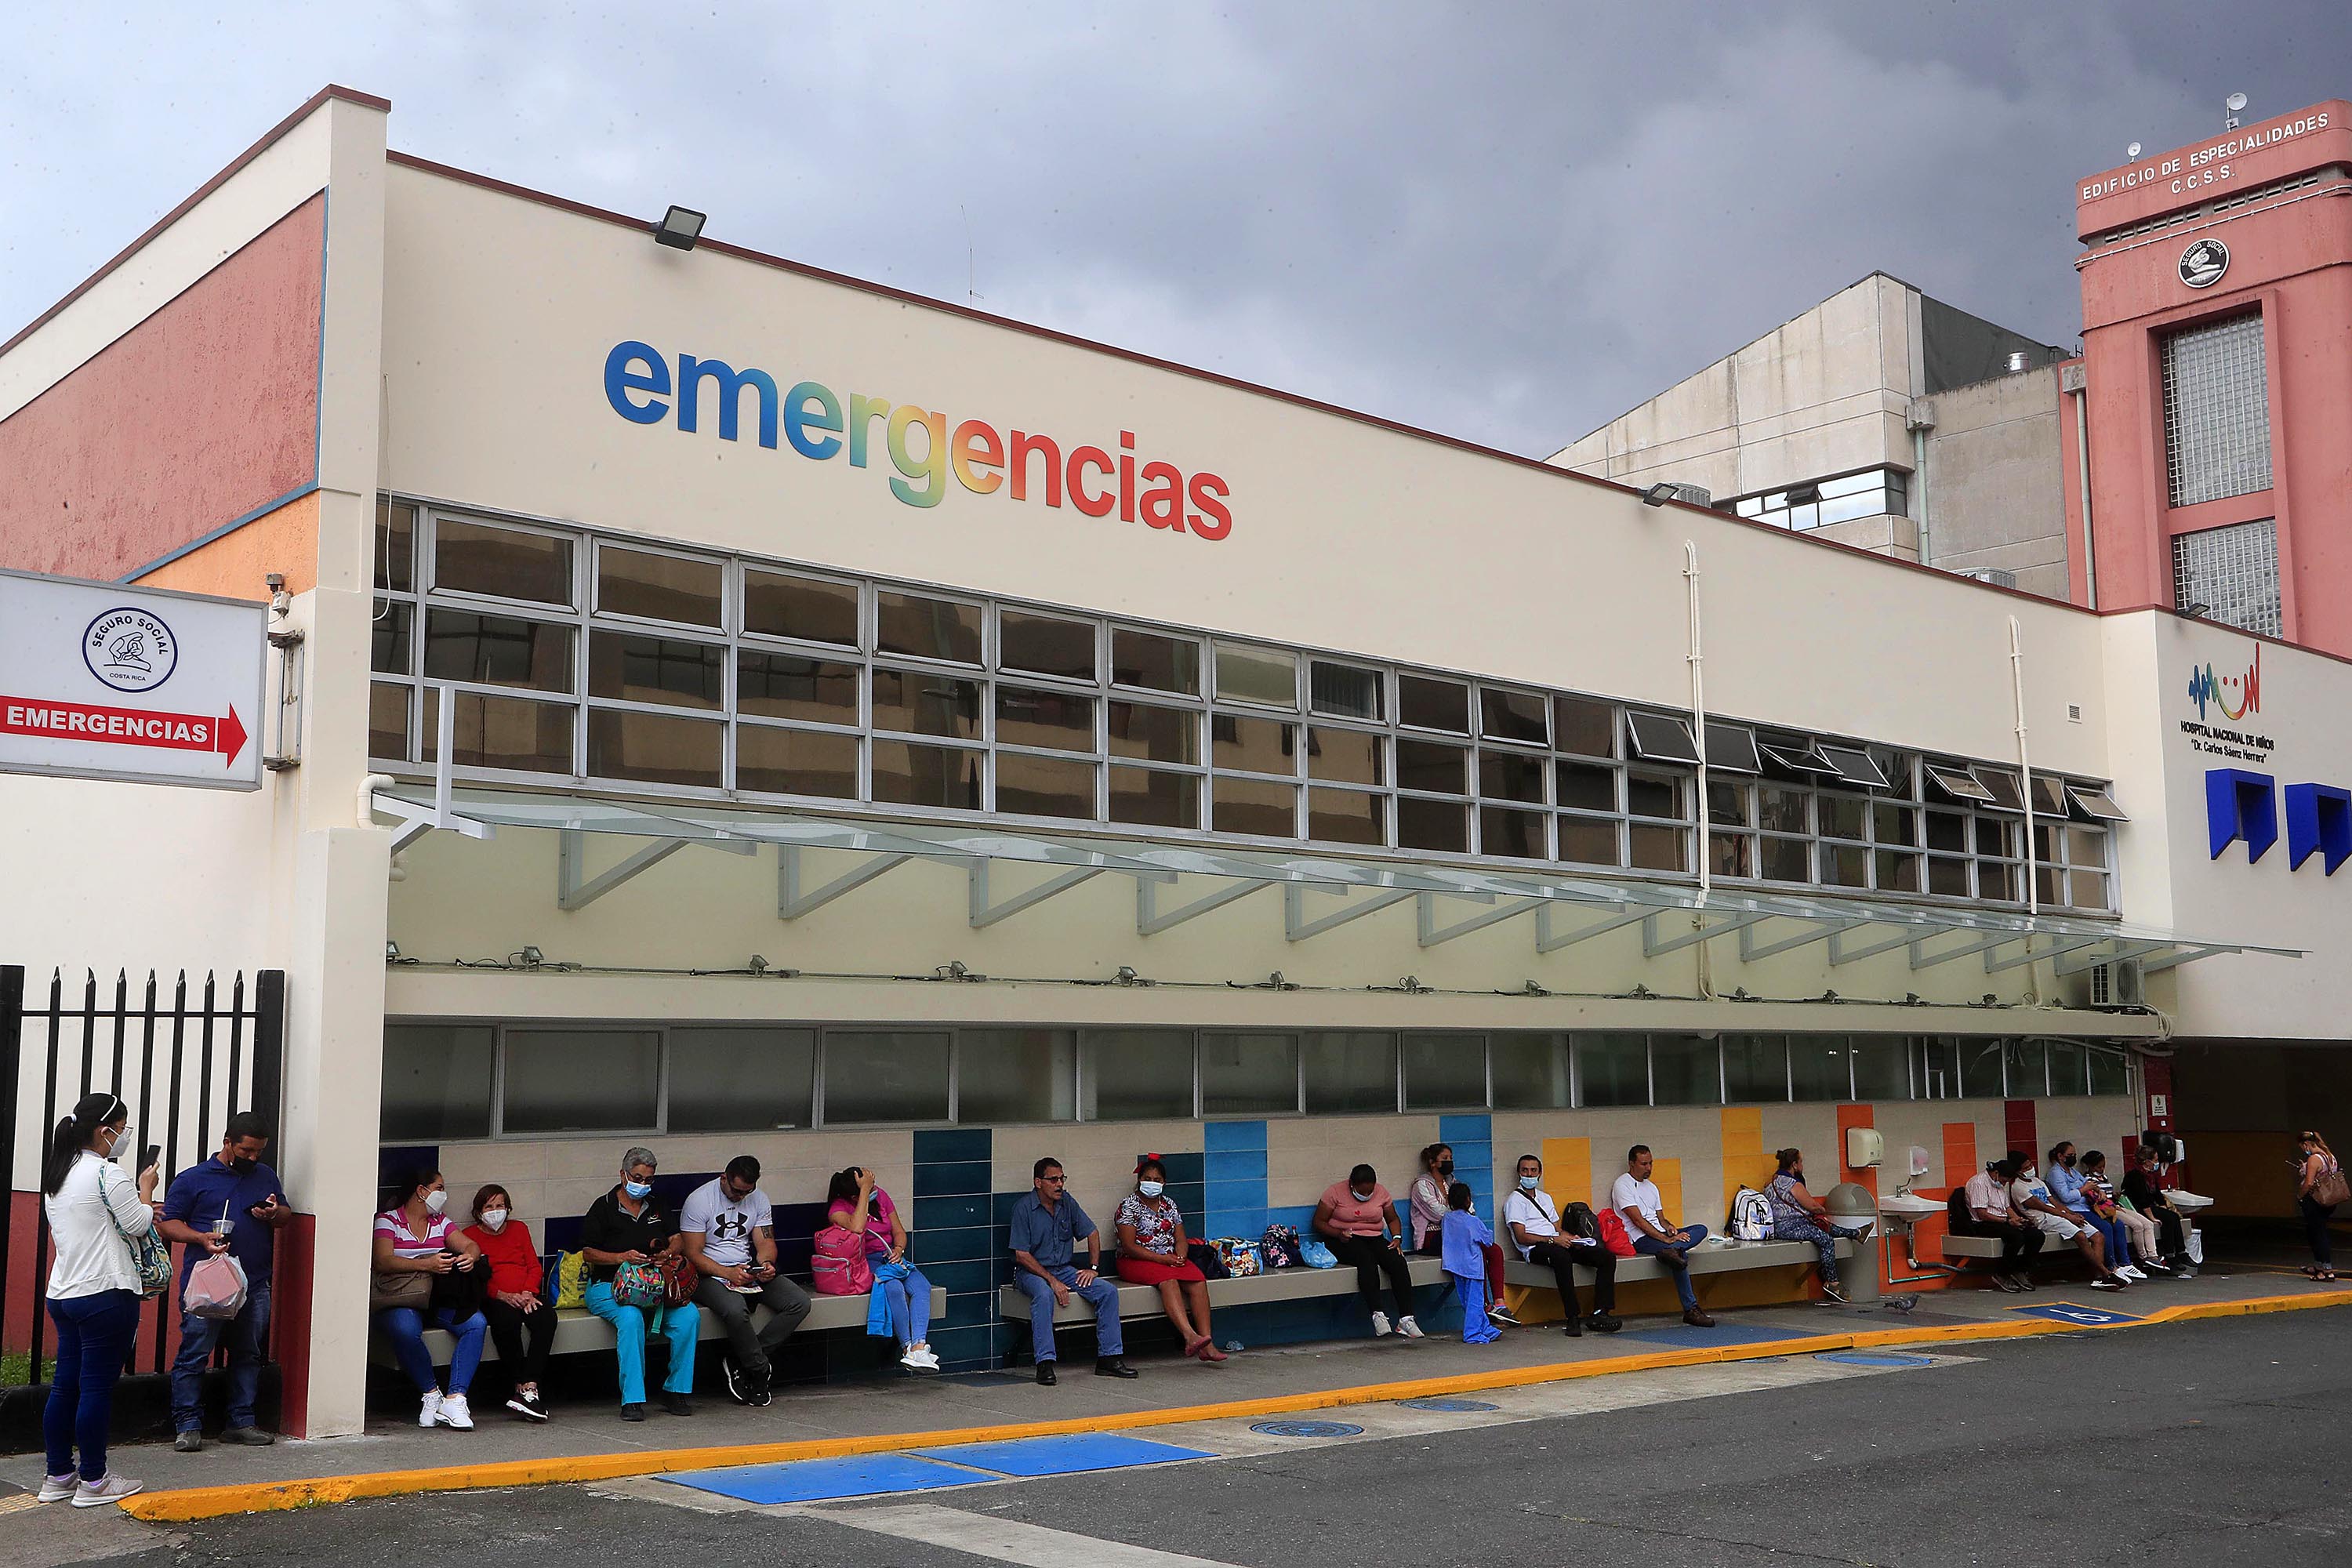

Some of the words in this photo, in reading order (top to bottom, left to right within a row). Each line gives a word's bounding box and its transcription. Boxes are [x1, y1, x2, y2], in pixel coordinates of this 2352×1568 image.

[2082, 167, 2155, 200] EDIFICIO
[2161, 158, 2181, 176] DE
[2189, 113, 2329, 167] ESPECIALIDADES
[2170, 164, 2236, 194] C.C.S.S.
[2181, 242, 2202, 267] SEGURO
[2206, 241, 2225, 256] SOCIAL
[603, 339, 1233, 541] emergencias
[92, 615, 132, 648] SEGURO
[136, 618, 169, 655] SOCIAL
[109, 672, 130, 681] COSTA
[6, 706, 209, 743] EMERGENCIAS
[2180, 720, 2212, 739] HOSPITAL
[2212, 727, 2245, 745] NACIONAL
[2245, 734, 2255, 747] DE
[2255, 735, 2274, 751] NIÑOS
[2204, 741, 2223, 755] Carlos
[2223, 746, 2242, 759] Sáenz
